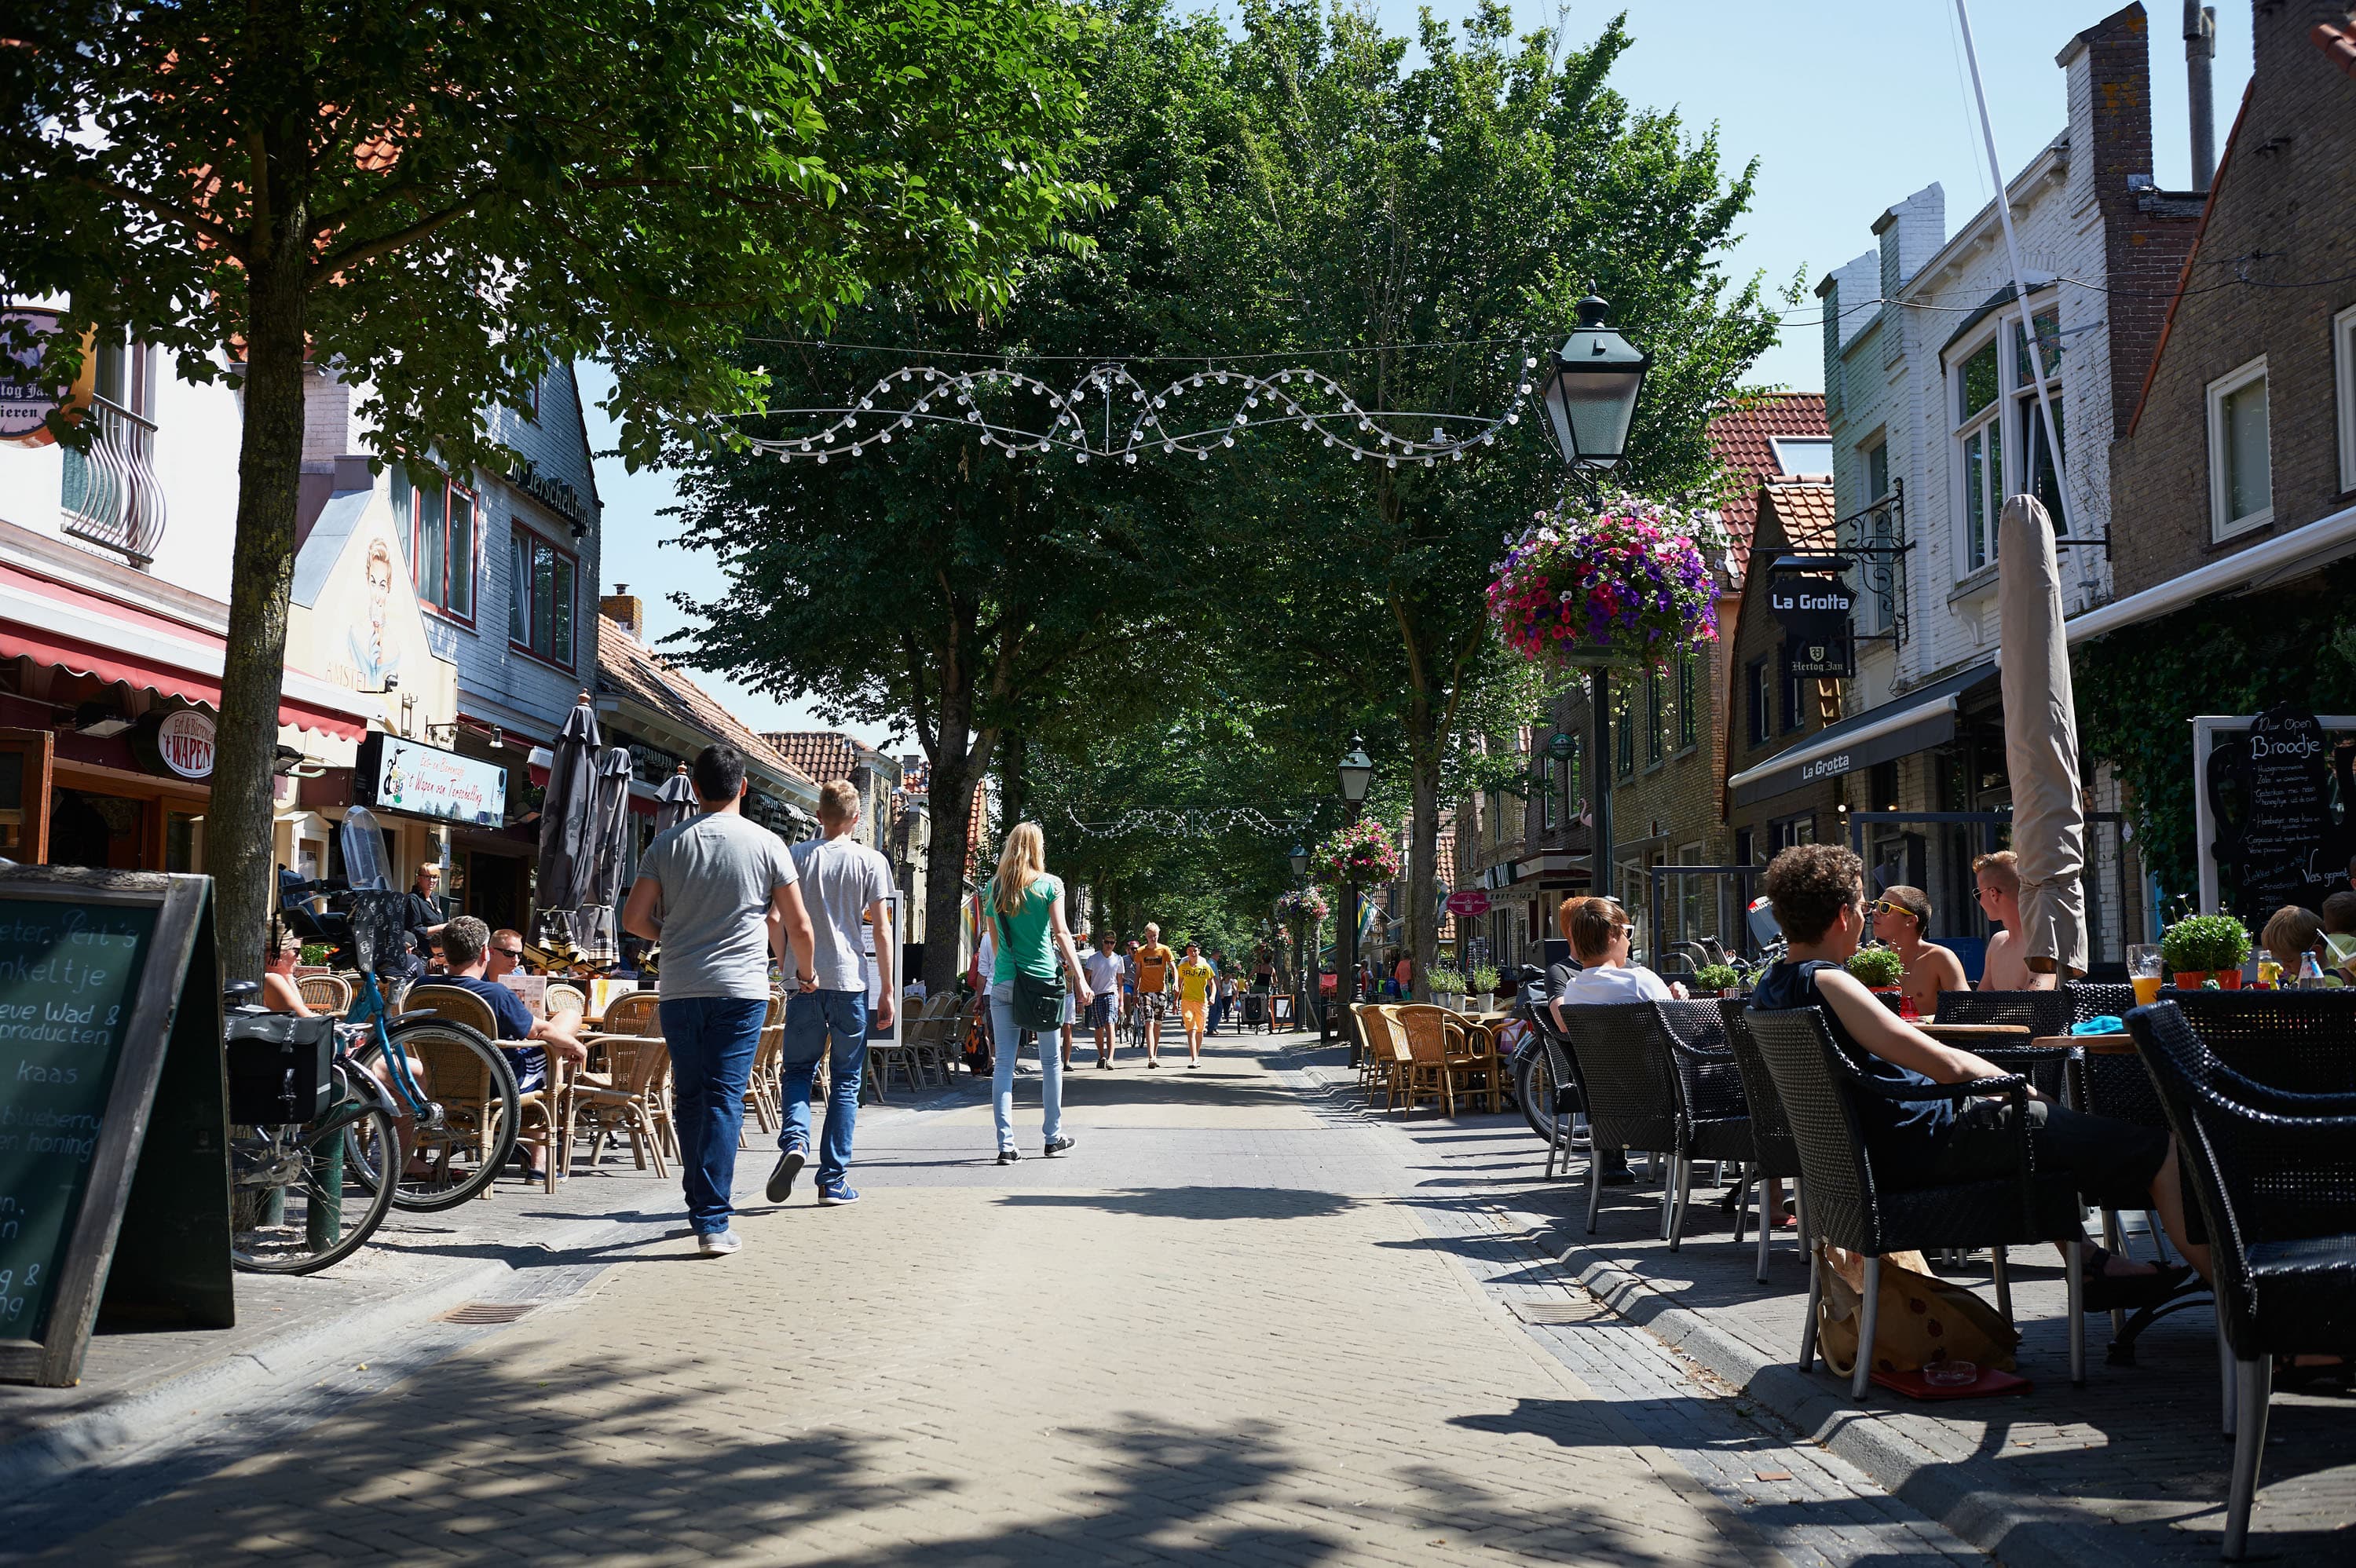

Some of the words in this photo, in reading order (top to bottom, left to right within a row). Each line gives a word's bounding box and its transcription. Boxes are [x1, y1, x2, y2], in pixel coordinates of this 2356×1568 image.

[526, 460, 592, 536] Terschelling
[1772, 594, 1794, 609] La
[1799, 594, 1849, 610] Grotta
[1791, 662, 1824, 672] Hertog
[1825, 662, 1842, 671] Jan
[2285, 718, 2312, 735] Open
[172, 735, 211, 769] WAPEN
[2250, 733, 2321, 759] Broodje
[1802, 766, 1813, 780] La
[1815, 755, 1849, 775] Grotta
[45, 1002, 95, 1024] Wad
[104, 1005, 121, 1025] &
[17, 1059, 78, 1084] kaas
[3, 1106, 103, 1140] blueberry
[27, 1131, 95, 1162] honing
[24, 1263, 40, 1286] &
